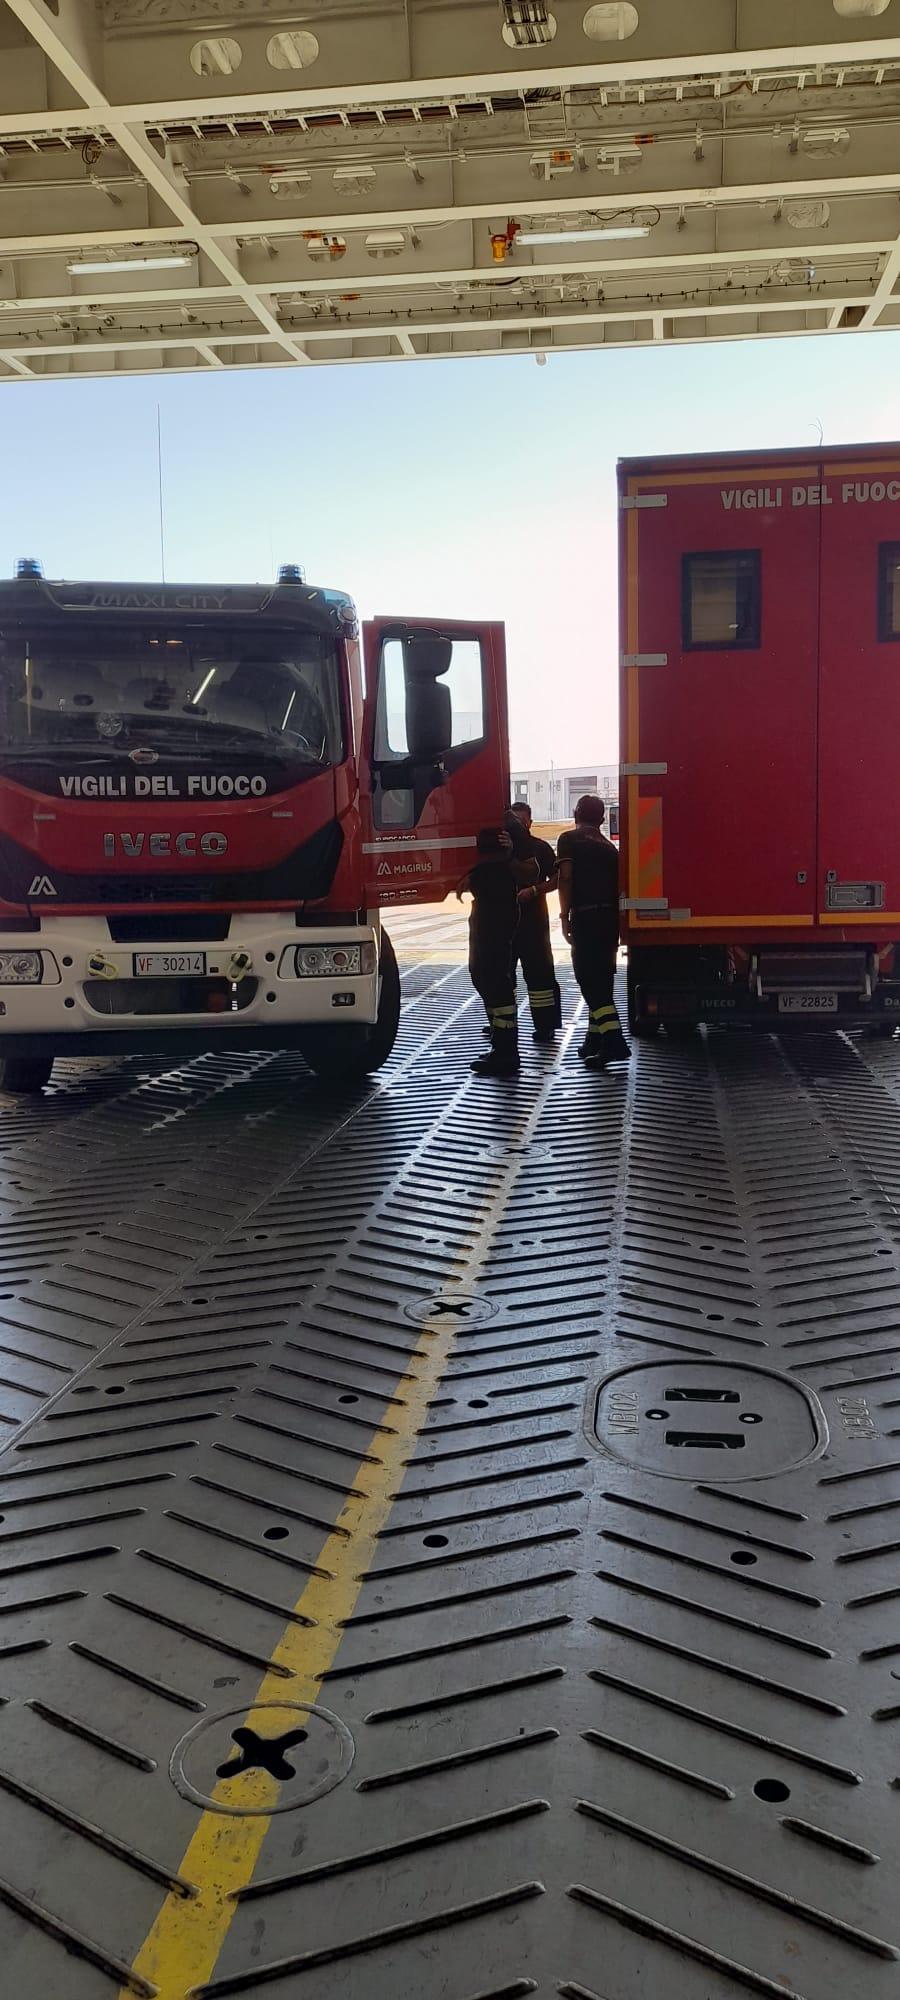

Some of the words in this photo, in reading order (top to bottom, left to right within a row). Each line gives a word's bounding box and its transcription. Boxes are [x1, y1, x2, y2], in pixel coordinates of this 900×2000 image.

[721, 488, 782, 509] VIGILI
[792, 485, 832, 506] DEL
[91, 593, 166, 607] MAXI
[175, 594, 228, 609] CITY
[59, 776, 126, 796] VIGILI
[134, 776, 180, 796] DEL
[188, 776, 267, 796] FUOCO
[103, 832, 228, 856] IVECO
[393, 862, 432, 875] MAGIRUS
[138, 957, 153, 972] VF
[162, 957, 200, 971] 30214
[701, 999, 736, 1008] IVECO
